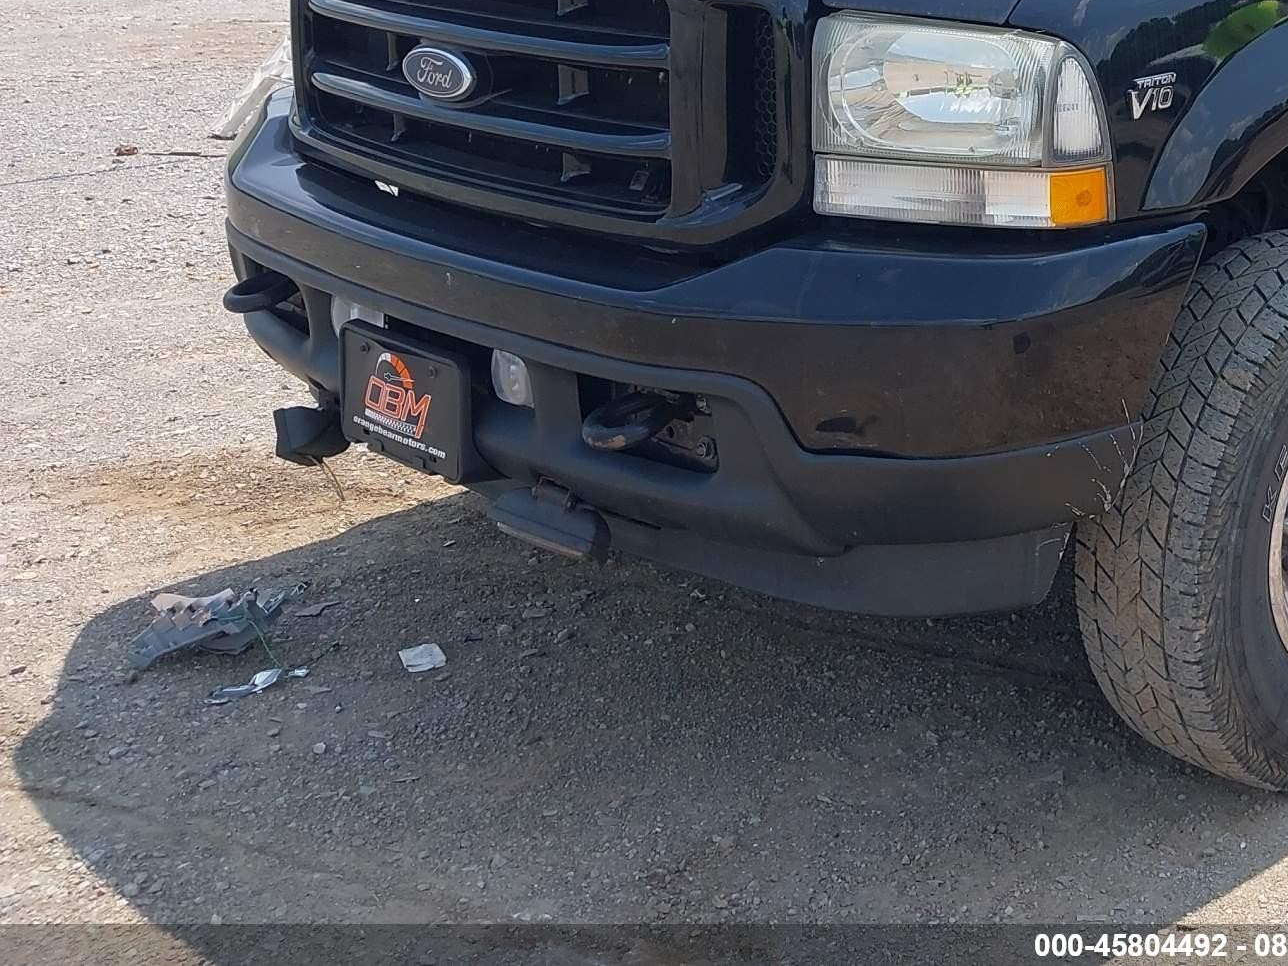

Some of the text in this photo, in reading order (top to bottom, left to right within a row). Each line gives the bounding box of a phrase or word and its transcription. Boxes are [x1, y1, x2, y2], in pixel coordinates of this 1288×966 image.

[417, 56, 452, 89] Ford
[1136, 74, 1176, 89] TRITON
[1128, 86, 1173, 120] V10
[365, 375, 431, 439] OBM
[353, 415, 446, 459] orangebearmotors.com
